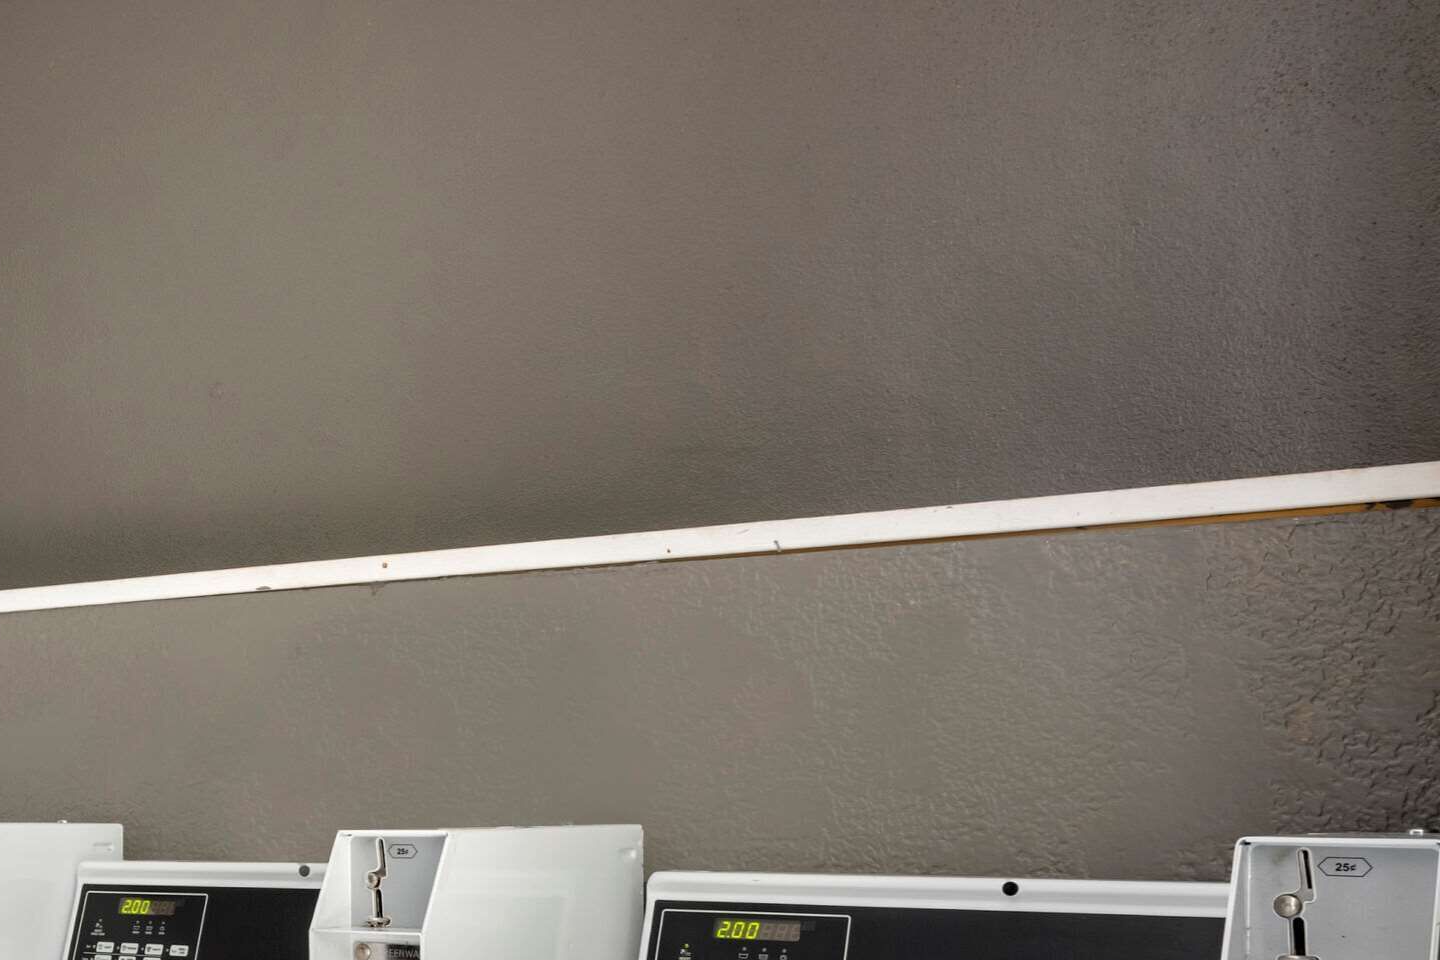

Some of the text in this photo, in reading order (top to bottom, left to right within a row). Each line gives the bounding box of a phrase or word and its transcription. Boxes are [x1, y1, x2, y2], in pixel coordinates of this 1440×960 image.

[1335, 862, 1357, 872] 25¢
[121, 899, 150, 914] 2.00
[716, 920, 760, 939] 2.00
